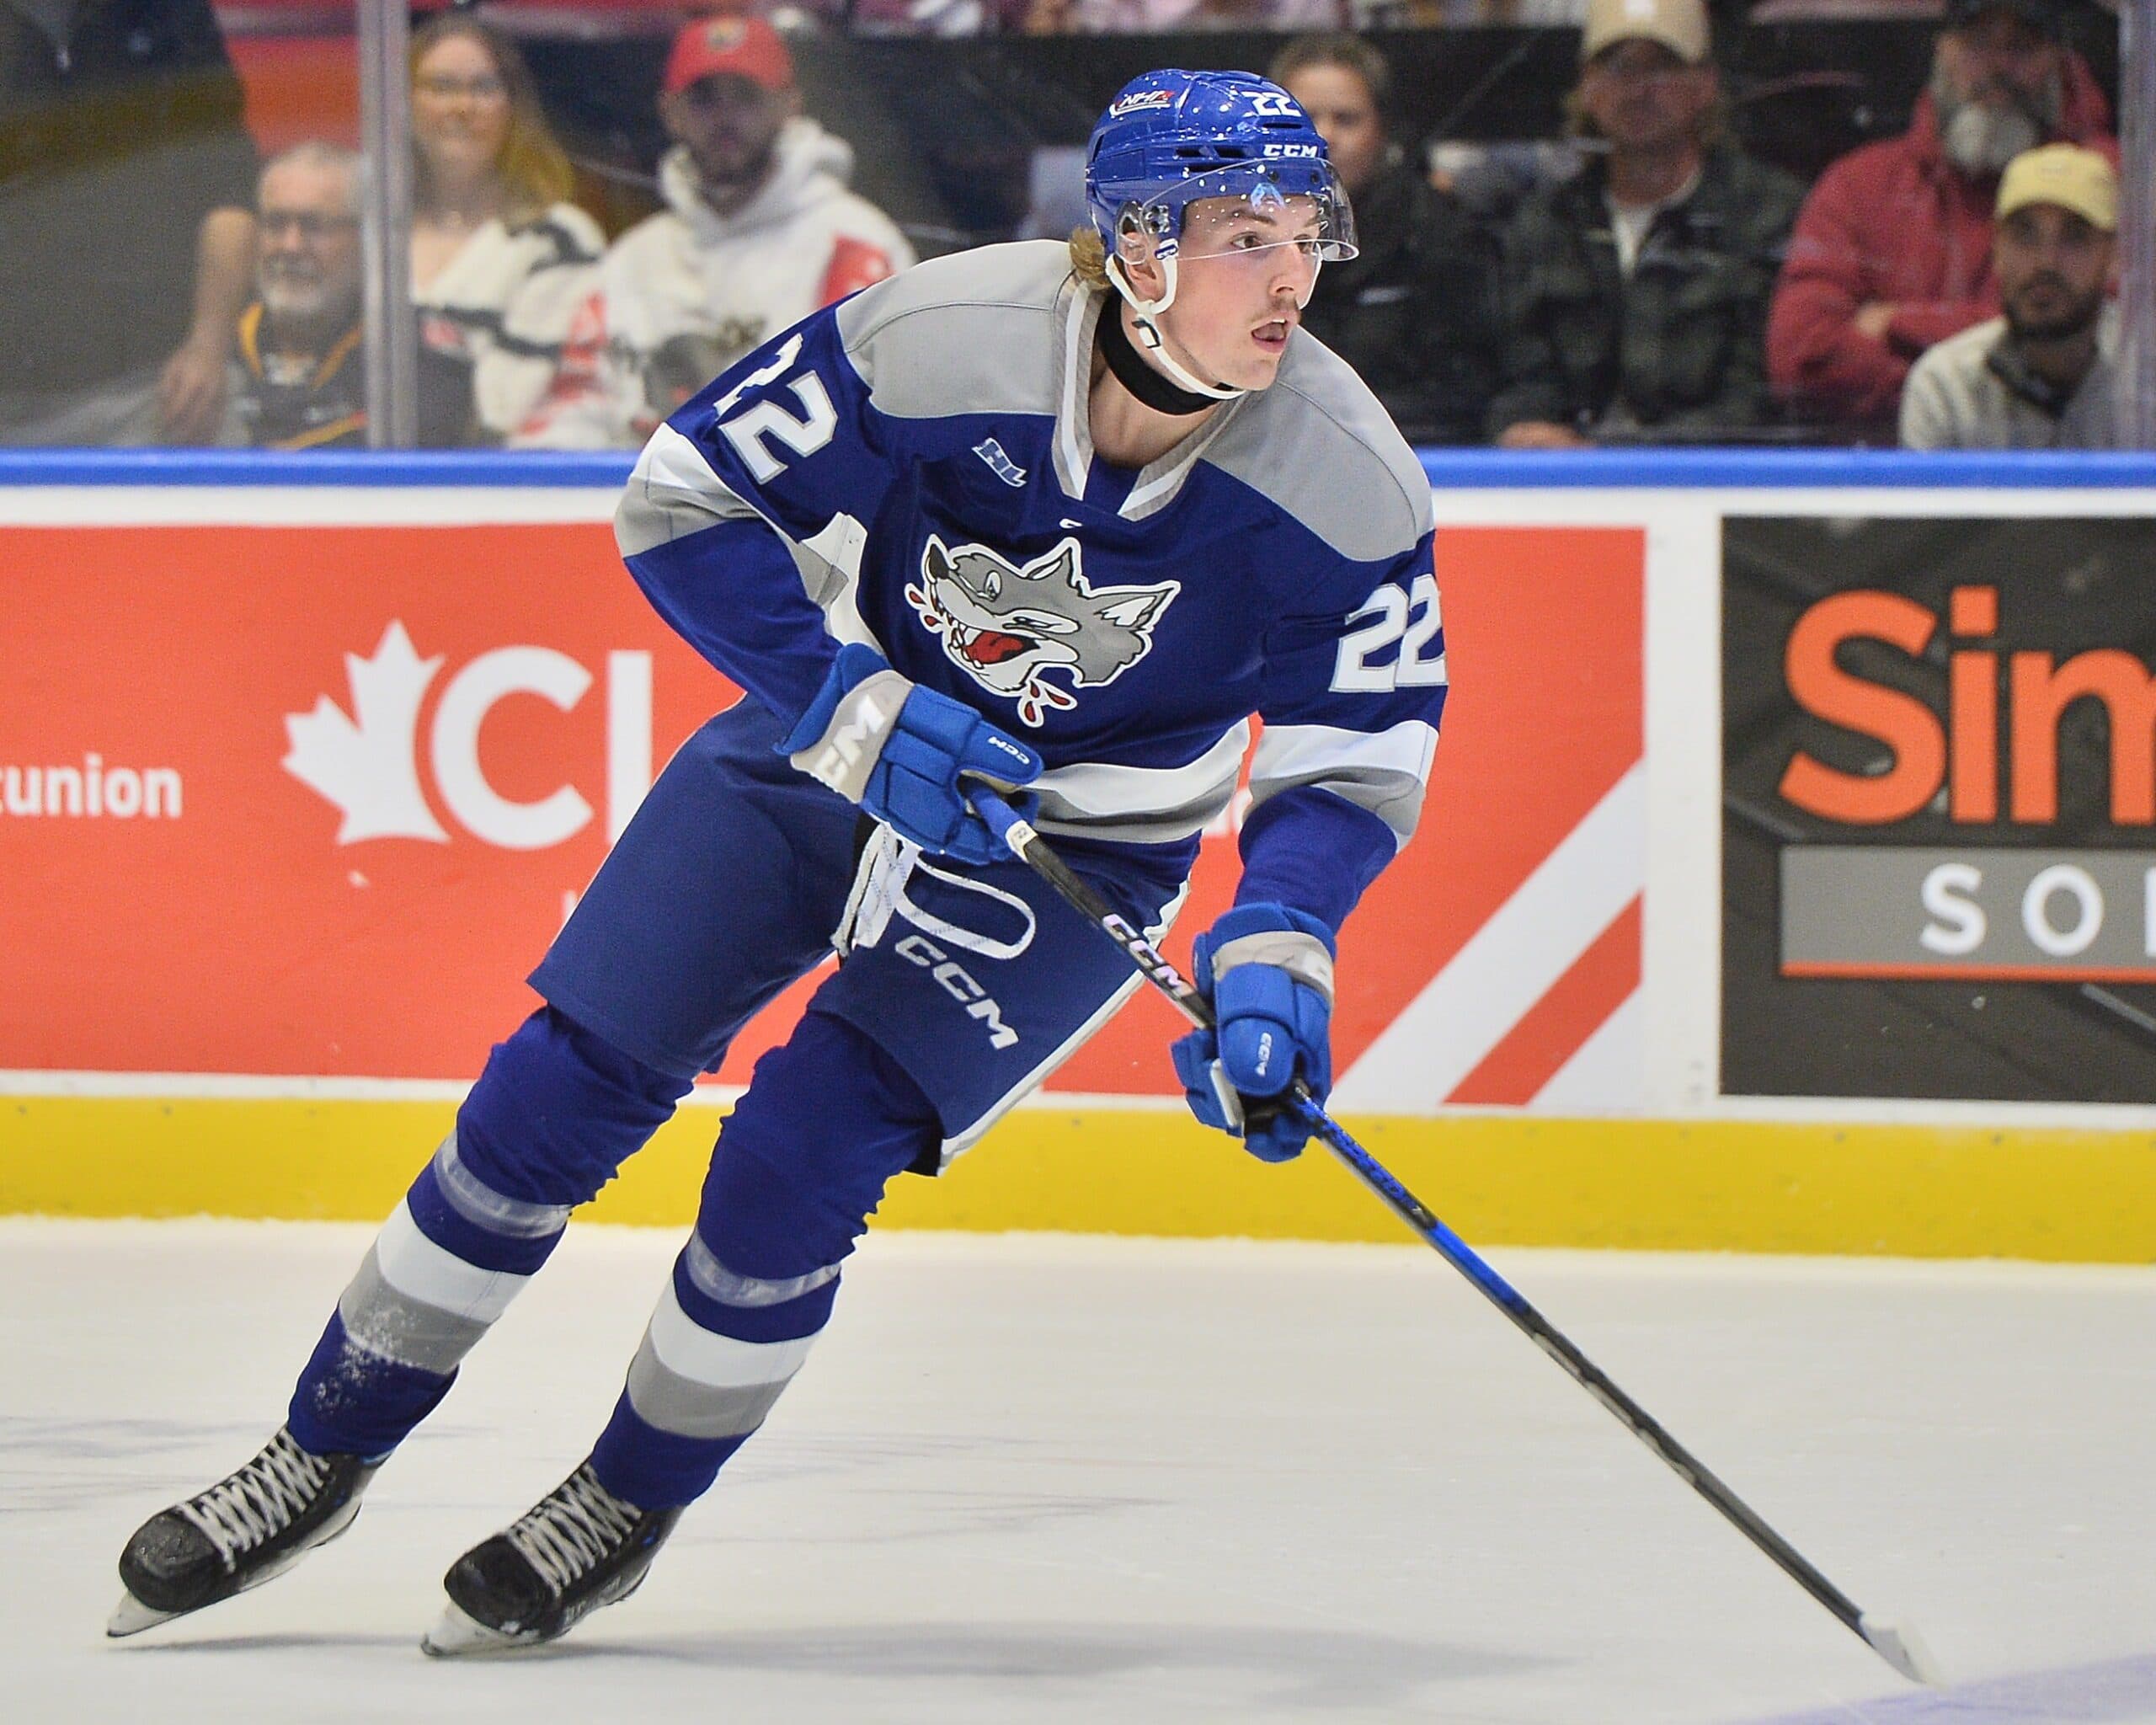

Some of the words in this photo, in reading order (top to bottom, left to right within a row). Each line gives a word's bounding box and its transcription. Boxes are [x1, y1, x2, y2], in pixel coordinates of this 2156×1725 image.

[1241, 91, 1302, 117] 22
[1264, 144, 1317, 158] CCM
[1328, 571, 1449, 693] 22
[988, 736, 1030, 765] CCM
[0, 751, 183, 817] union
[1920, 863, 2156, 957] SO
[1102, 913, 1194, 997] CCM
[895, 934, 1019, 1050] CCM
[1256, 1032, 1273, 1077] CCM
